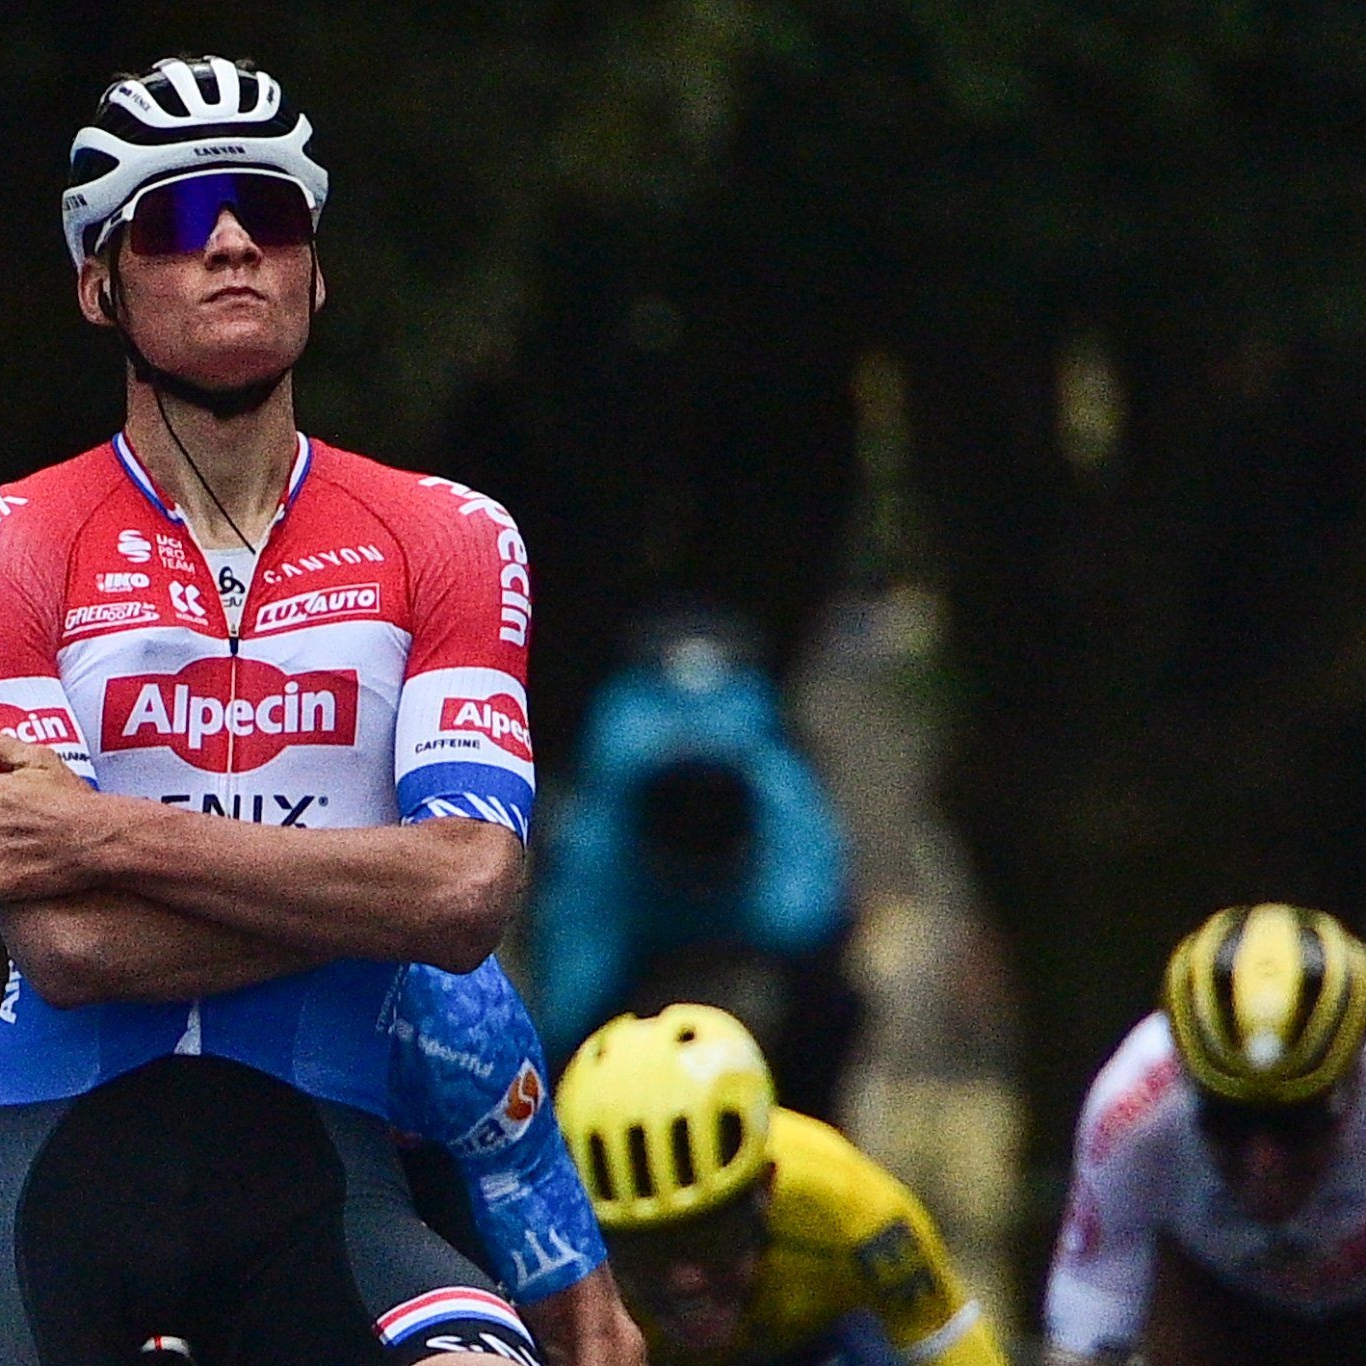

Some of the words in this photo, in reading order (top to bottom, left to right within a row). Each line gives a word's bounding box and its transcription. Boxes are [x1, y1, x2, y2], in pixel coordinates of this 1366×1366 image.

[156, 534, 182, 549] UCI
[158, 546, 185, 559] PRO
[162, 556, 195, 573] TEAM
[418, 476, 532, 647] pecin
[121, 681, 336, 750] Alpecin
[415, 738, 480, 753] CAFFEINE
